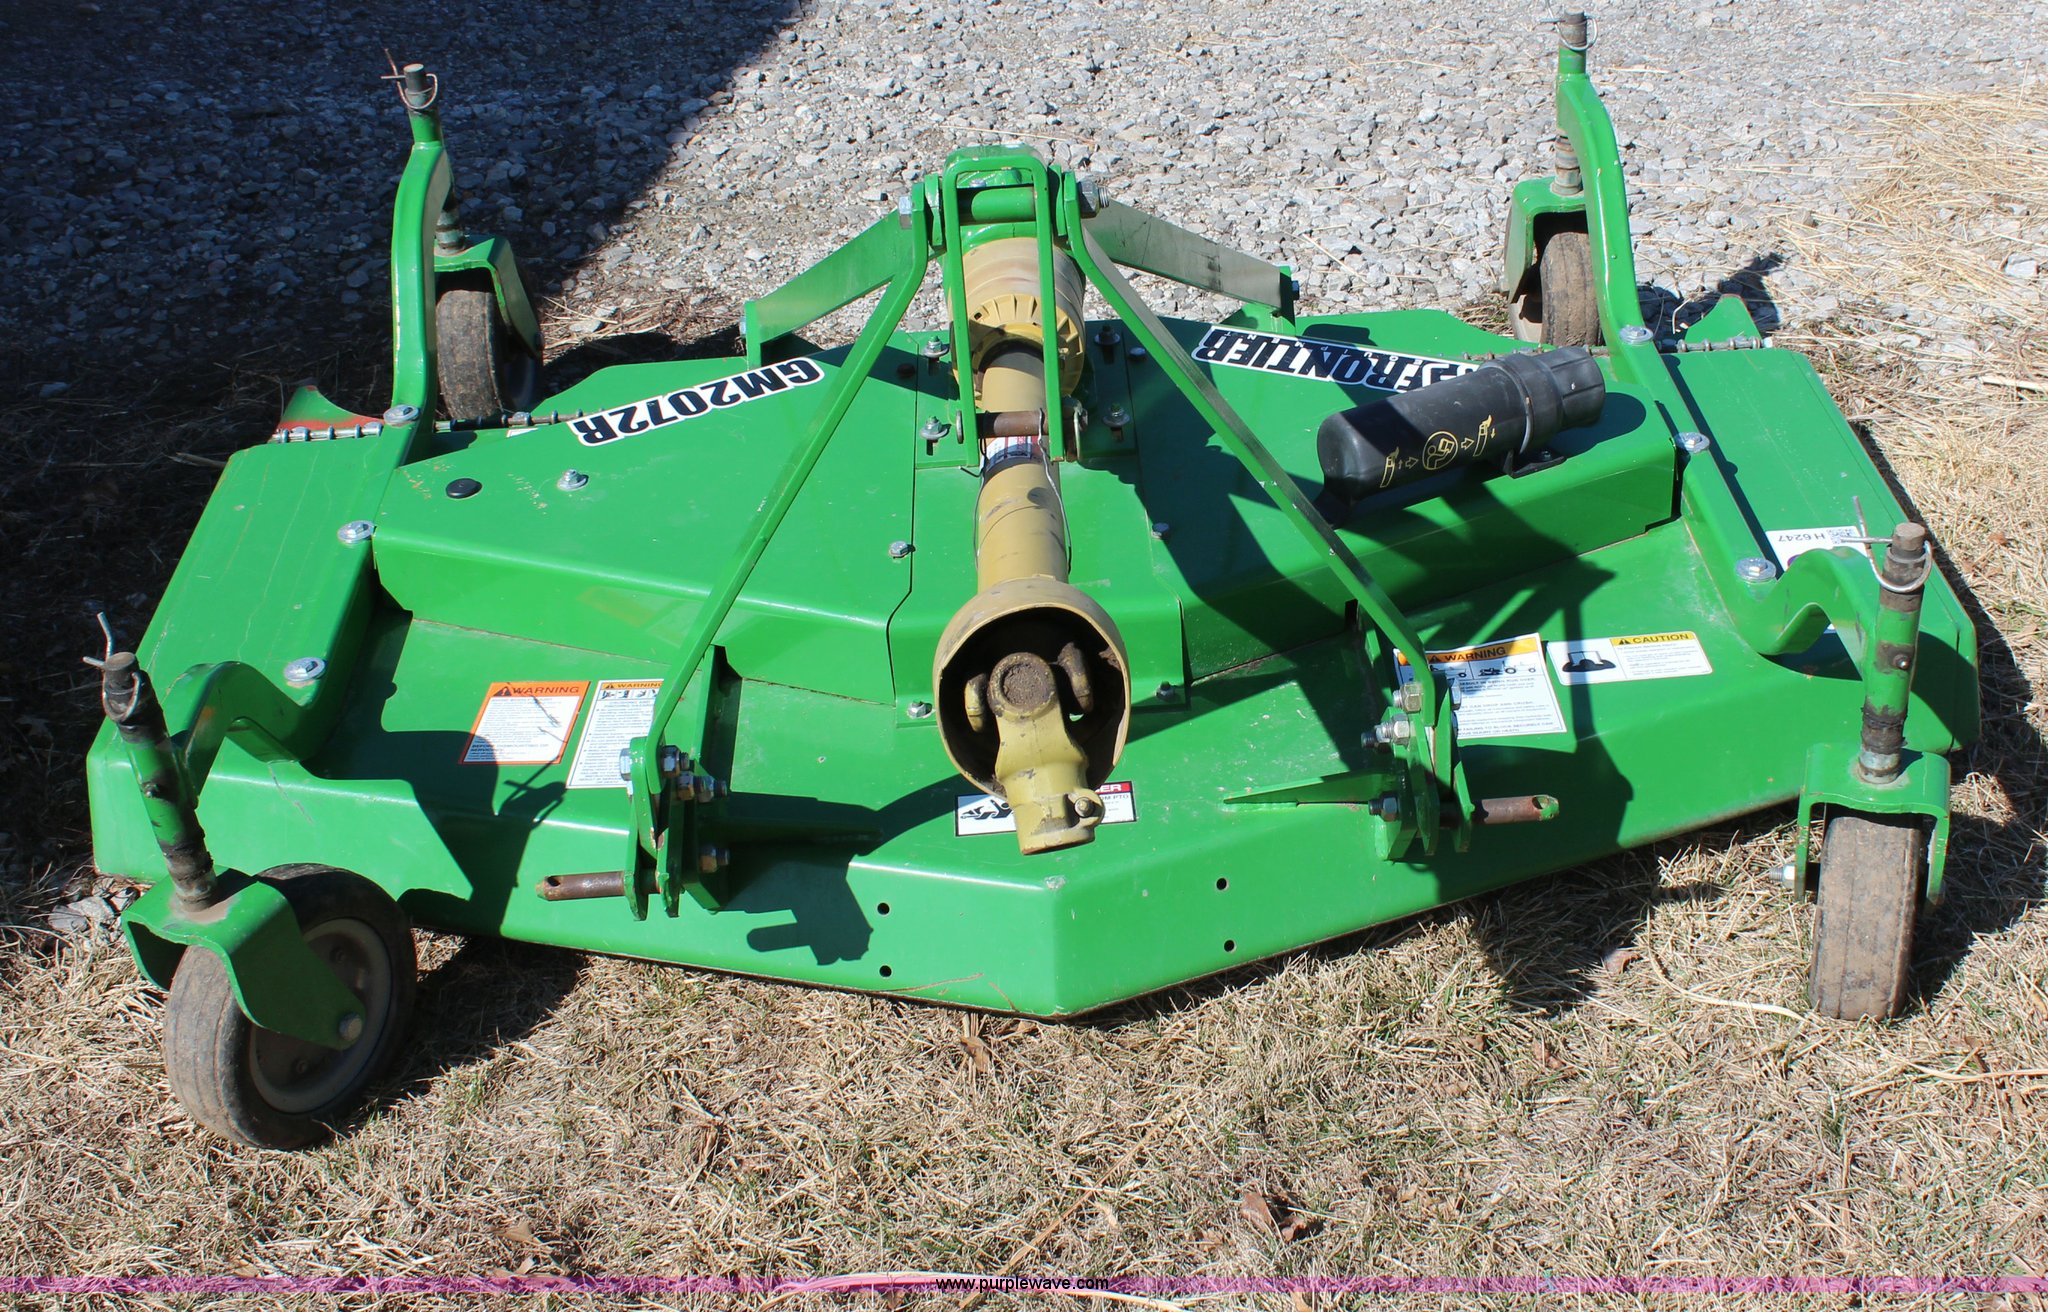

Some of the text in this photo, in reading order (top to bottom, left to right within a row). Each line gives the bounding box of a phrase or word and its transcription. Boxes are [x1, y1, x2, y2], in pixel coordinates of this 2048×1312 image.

[1224, 332, 1422, 365] EQUIPMENT
[1193, 328, 1430, 392] FRONTIER
[571, 358, 822, 445] GM2072R
[1778, 533, 1811, 542] 6247
[1632, 633, 1689, 644] CAUTION
[1444, 646, 1506, 661] WARNING
[512, 686, 579, 694] WARNING
